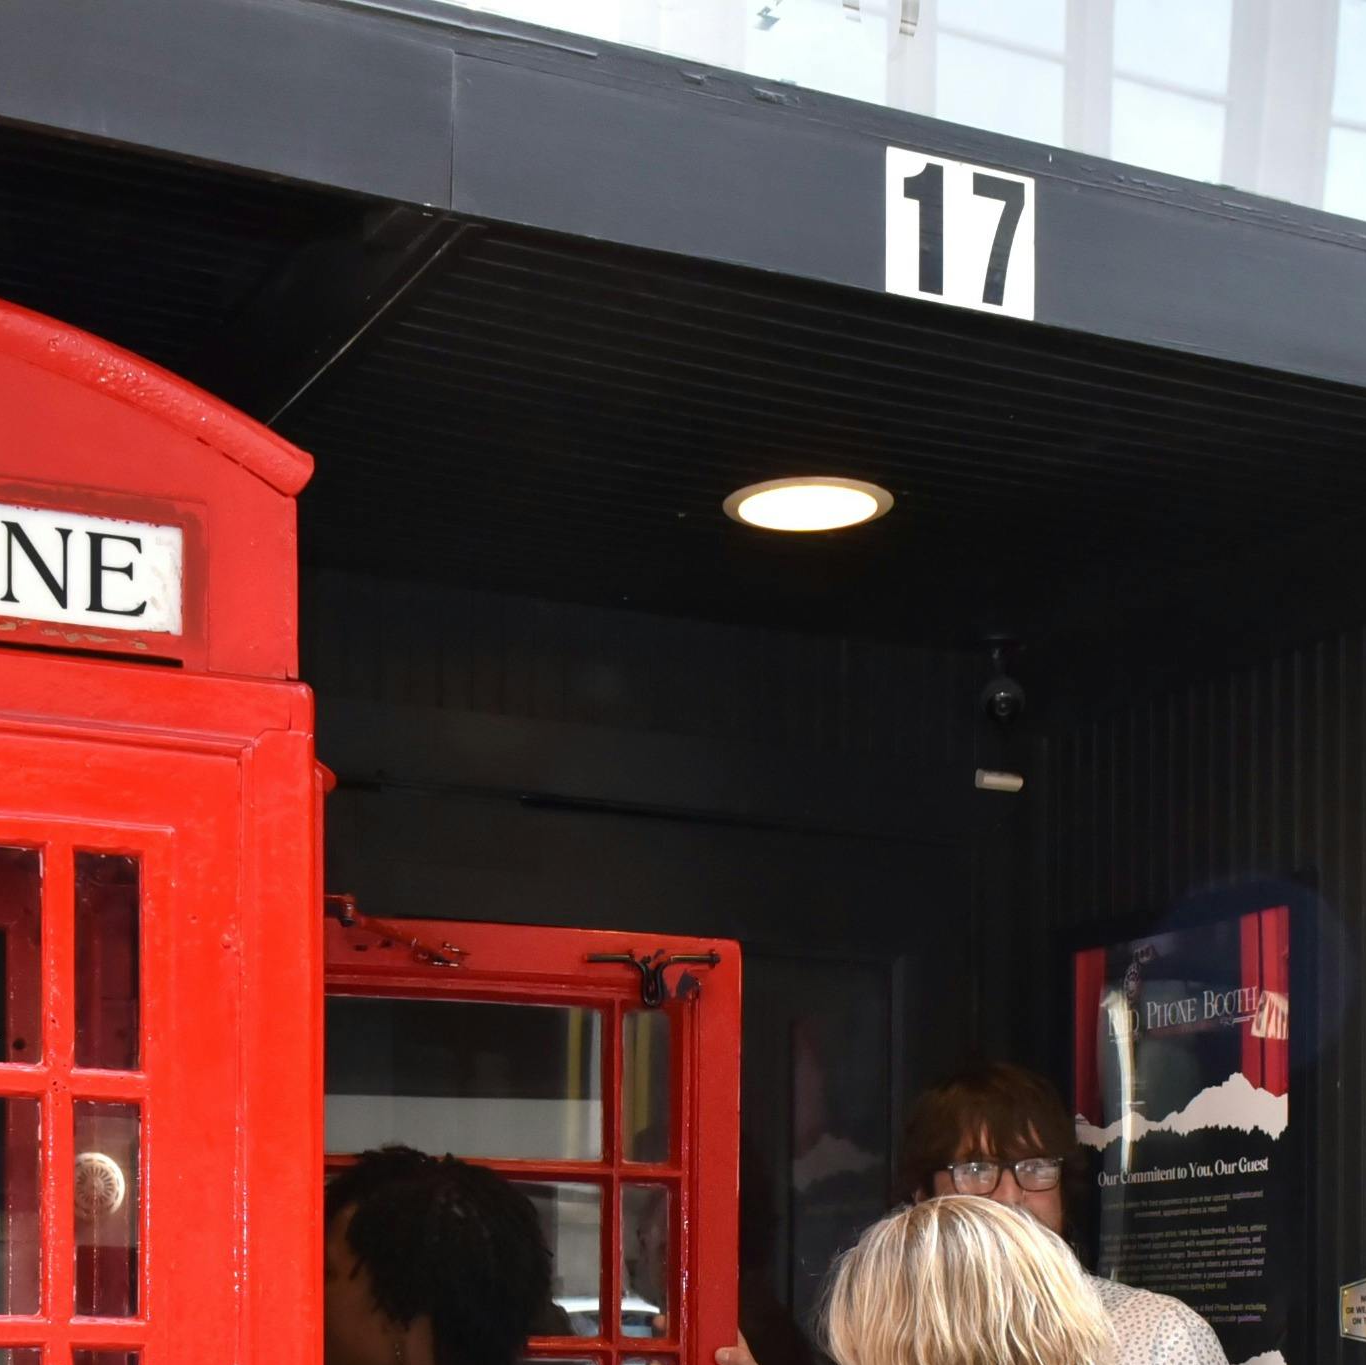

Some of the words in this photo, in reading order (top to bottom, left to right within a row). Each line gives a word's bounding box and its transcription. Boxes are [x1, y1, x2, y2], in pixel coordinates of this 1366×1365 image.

[903, 162, 1026, 306] 17
[1108, 1008, 1140, 1037] RD
[1146, 998, 1198, 1030] PHONE
[1203, 986, 1258, 1019] BOOTH
[1098, 1172, 1120, 1187] Our
[1177, 1166, 1187, 1180] to
[1188, 1161, 1213, 1179] You,
[1214, 1159, 1238, 1176] Our
[1238, 1156, 1269, 1173] Guest
[1345, 1306, 1355, 1314] OR
[1352, 1317, 1362, 1325] ON
